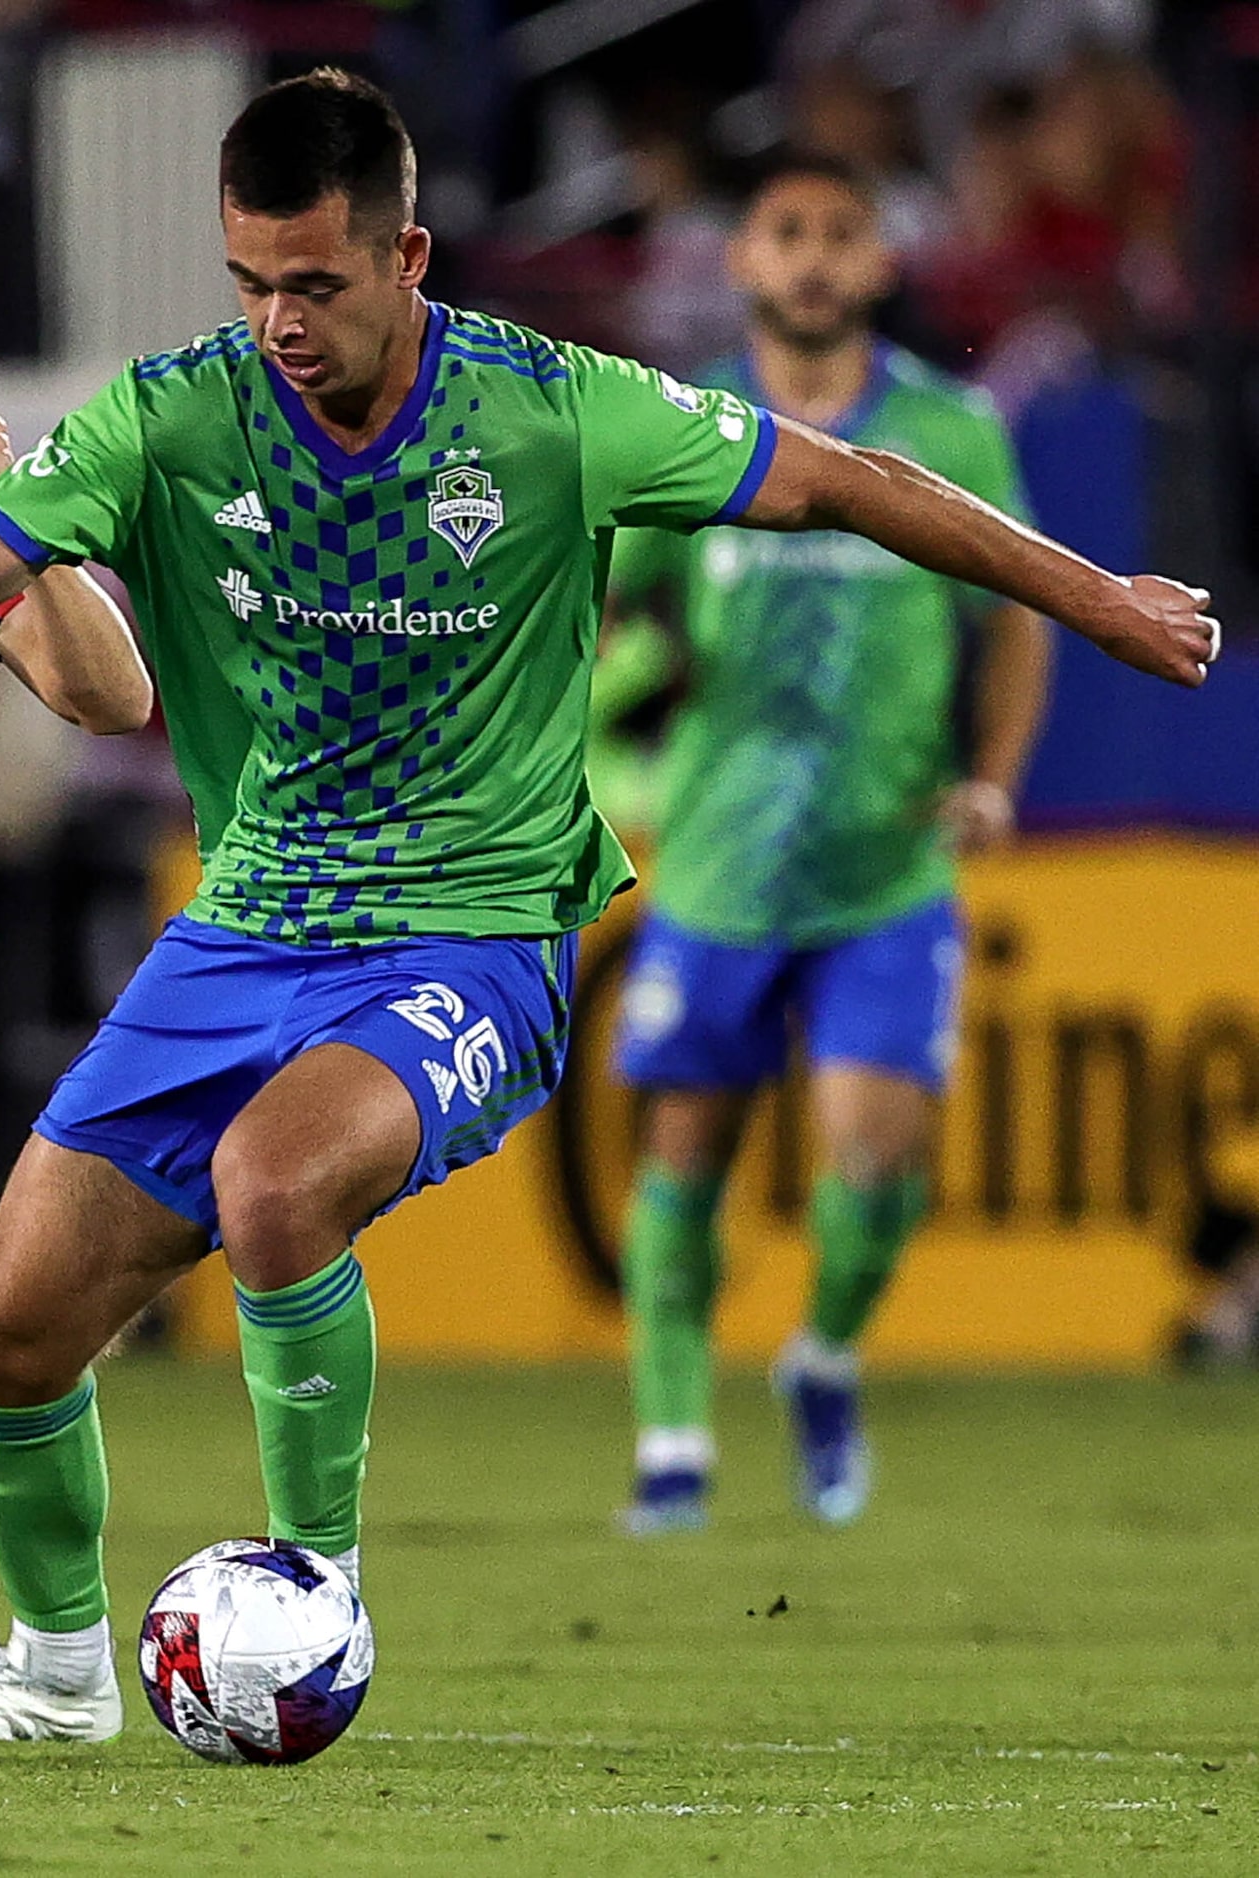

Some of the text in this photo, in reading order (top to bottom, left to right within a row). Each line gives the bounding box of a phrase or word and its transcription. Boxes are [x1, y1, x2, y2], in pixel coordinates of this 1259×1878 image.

[214, 510, 272, 534] adidas
[271, 594, 500, 637] Providence
[386, 981, 508, 1108] 26
